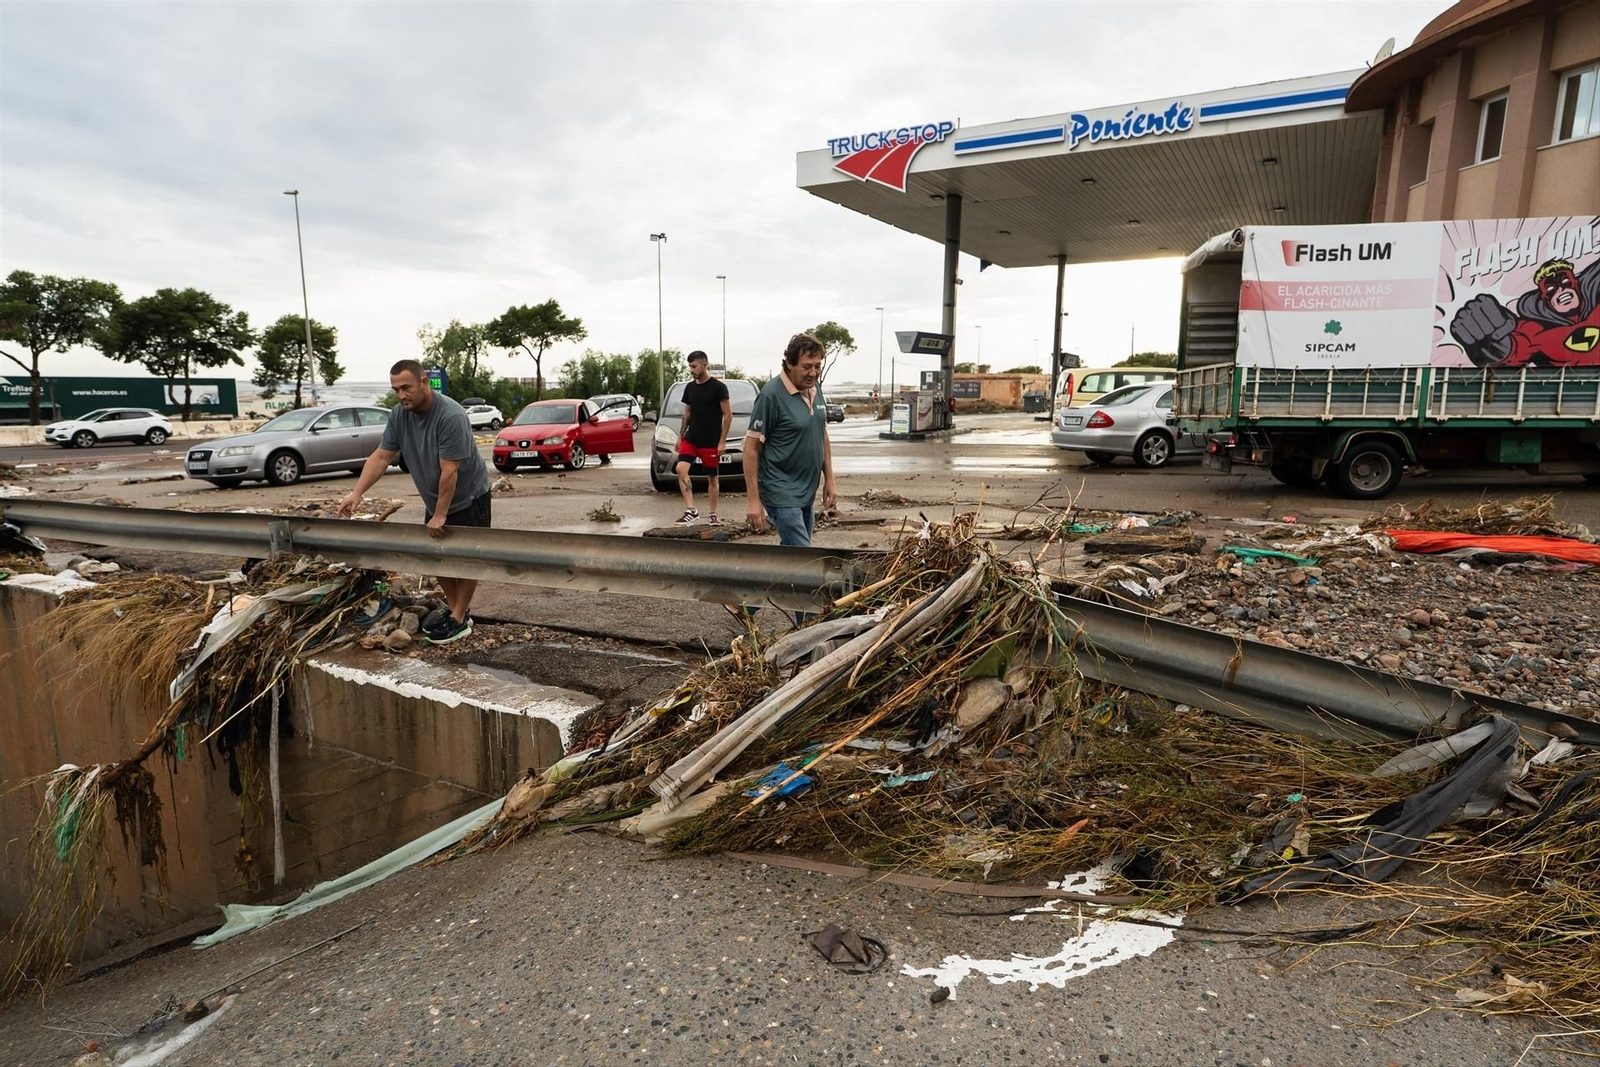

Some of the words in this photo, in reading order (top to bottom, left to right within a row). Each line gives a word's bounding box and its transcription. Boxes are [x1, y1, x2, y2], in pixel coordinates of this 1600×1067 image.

[1070, 101, 1192, 146] Poniente
[827, 131, 892, 156] TRUCK
[895, 121, 954, 145] STOP
[1295, 244, 1352, 262] Flash
[1358, 242, 1392, 261] UM
[1455, 234, 1542, 280] FLASH
[1278, 285, 1293, 296] EL
[1296, 285, 1361, 296] ACARICIDA
[1365, 283, 1393, 295] MÁS
[1284, 297, 1384, 309] FLASH-CINANTE
[1305, 343, 1356, 352] SIPCAM
